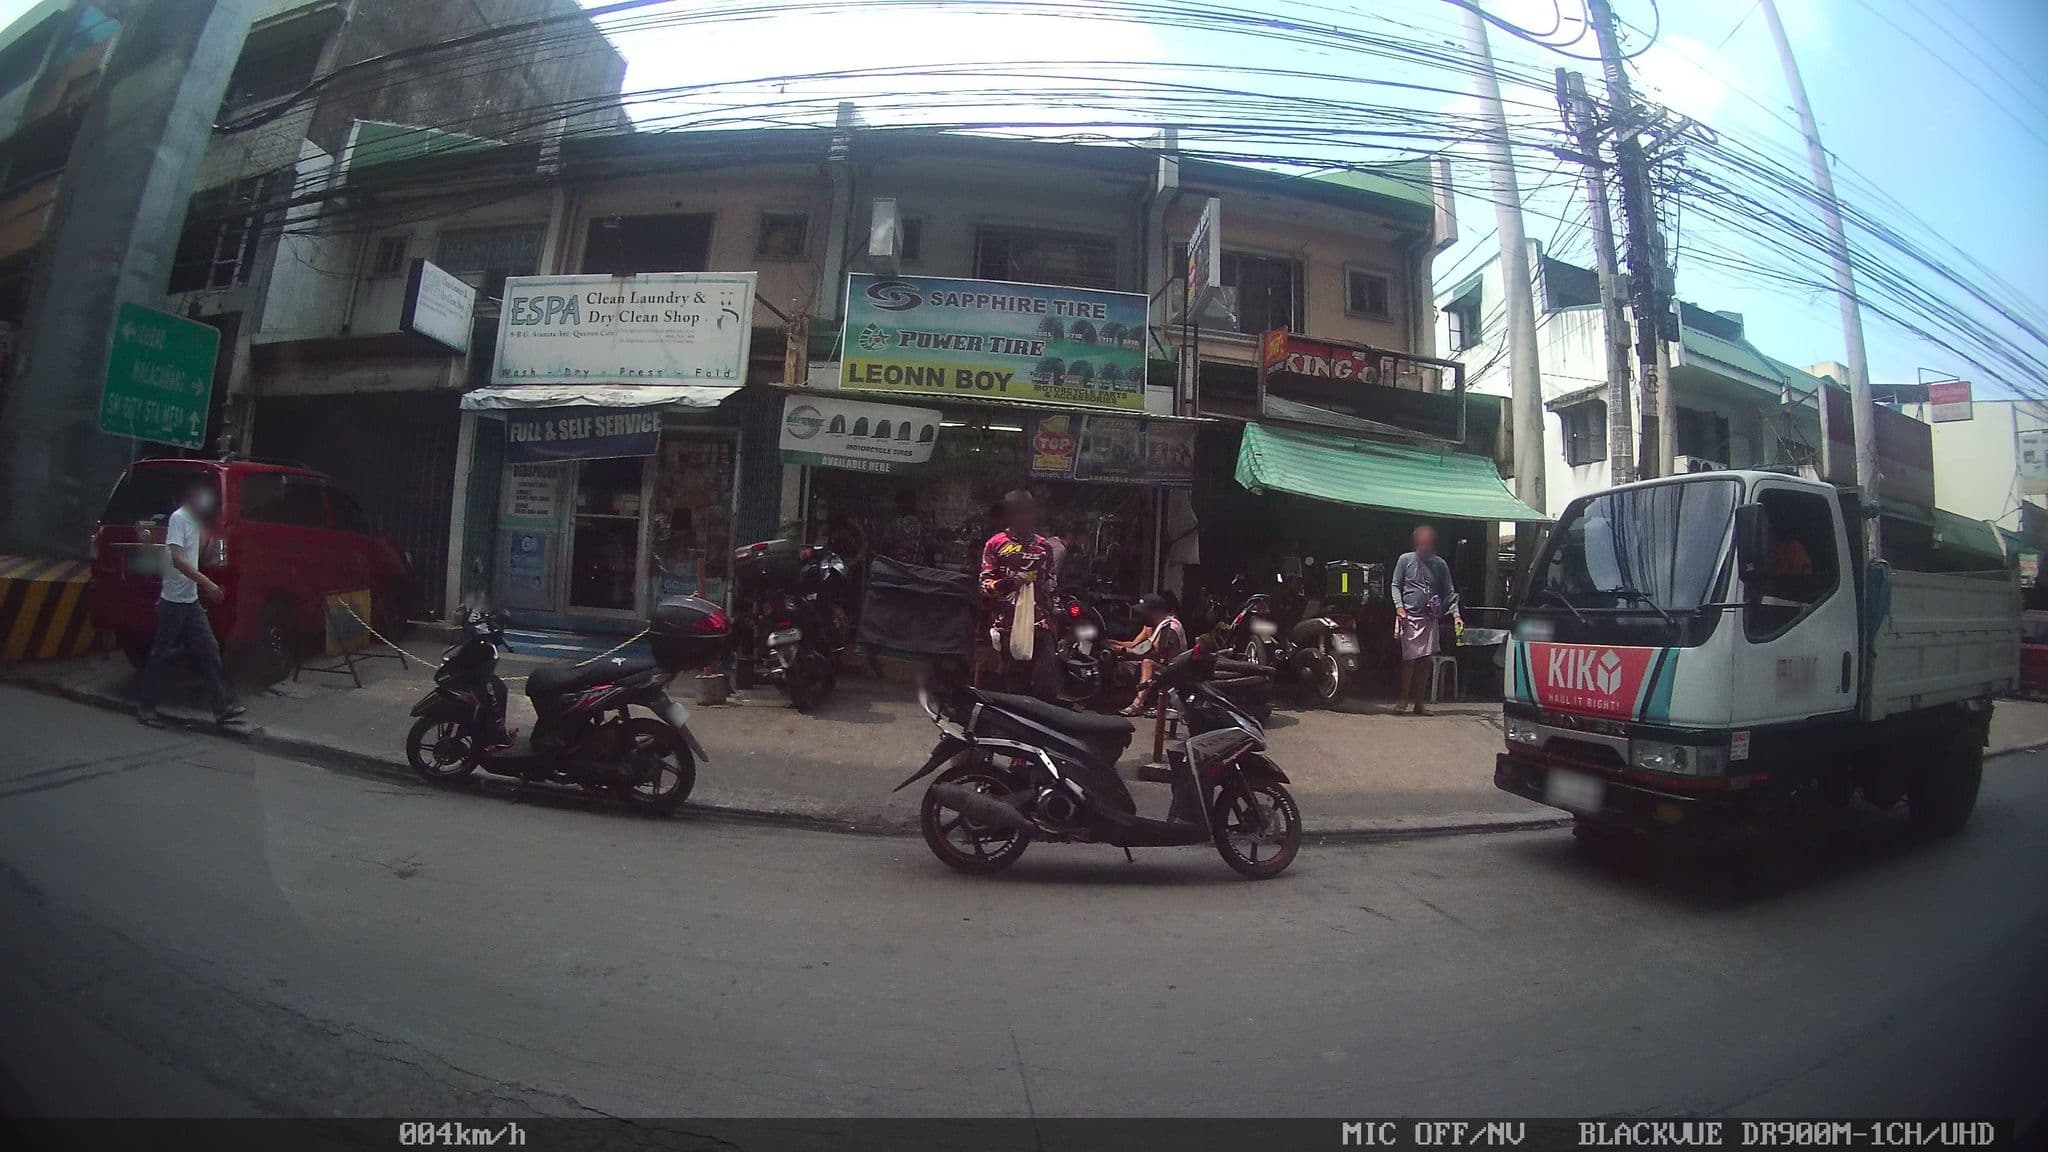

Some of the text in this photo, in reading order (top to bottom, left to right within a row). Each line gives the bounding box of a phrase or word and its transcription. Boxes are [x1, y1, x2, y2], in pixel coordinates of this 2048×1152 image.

[587, 291, 706, 308] Clean Laundry &
[930, 291, 1107, 320] SAPPHIRE TIRE
[511, 295, 580, 326] ESPA
[588, 310, 700, 327] Dry Clean Shop
[898, 330, 984, 352] POWER
[988, 336, 1045, 357] TIRE
[565, 368, 590, 377] Dry
[619, 367, 663, 378] Press
[695, 368, 731, 378] Fold
[1284, 353, 1353, 379] KING
[849, 363, 945, 388] LEONN
[956, 369, 1014, 392] BOY
[510, 411, 663, 443] FULL & SELF SERVICE
[1039, 438, 1069, 450] TOP
[822, 456, 890, 472] AVAILABLE HERE
[1549, 693, 1570, 705] HAUL
[1573, 696, 1583, 706] IT
